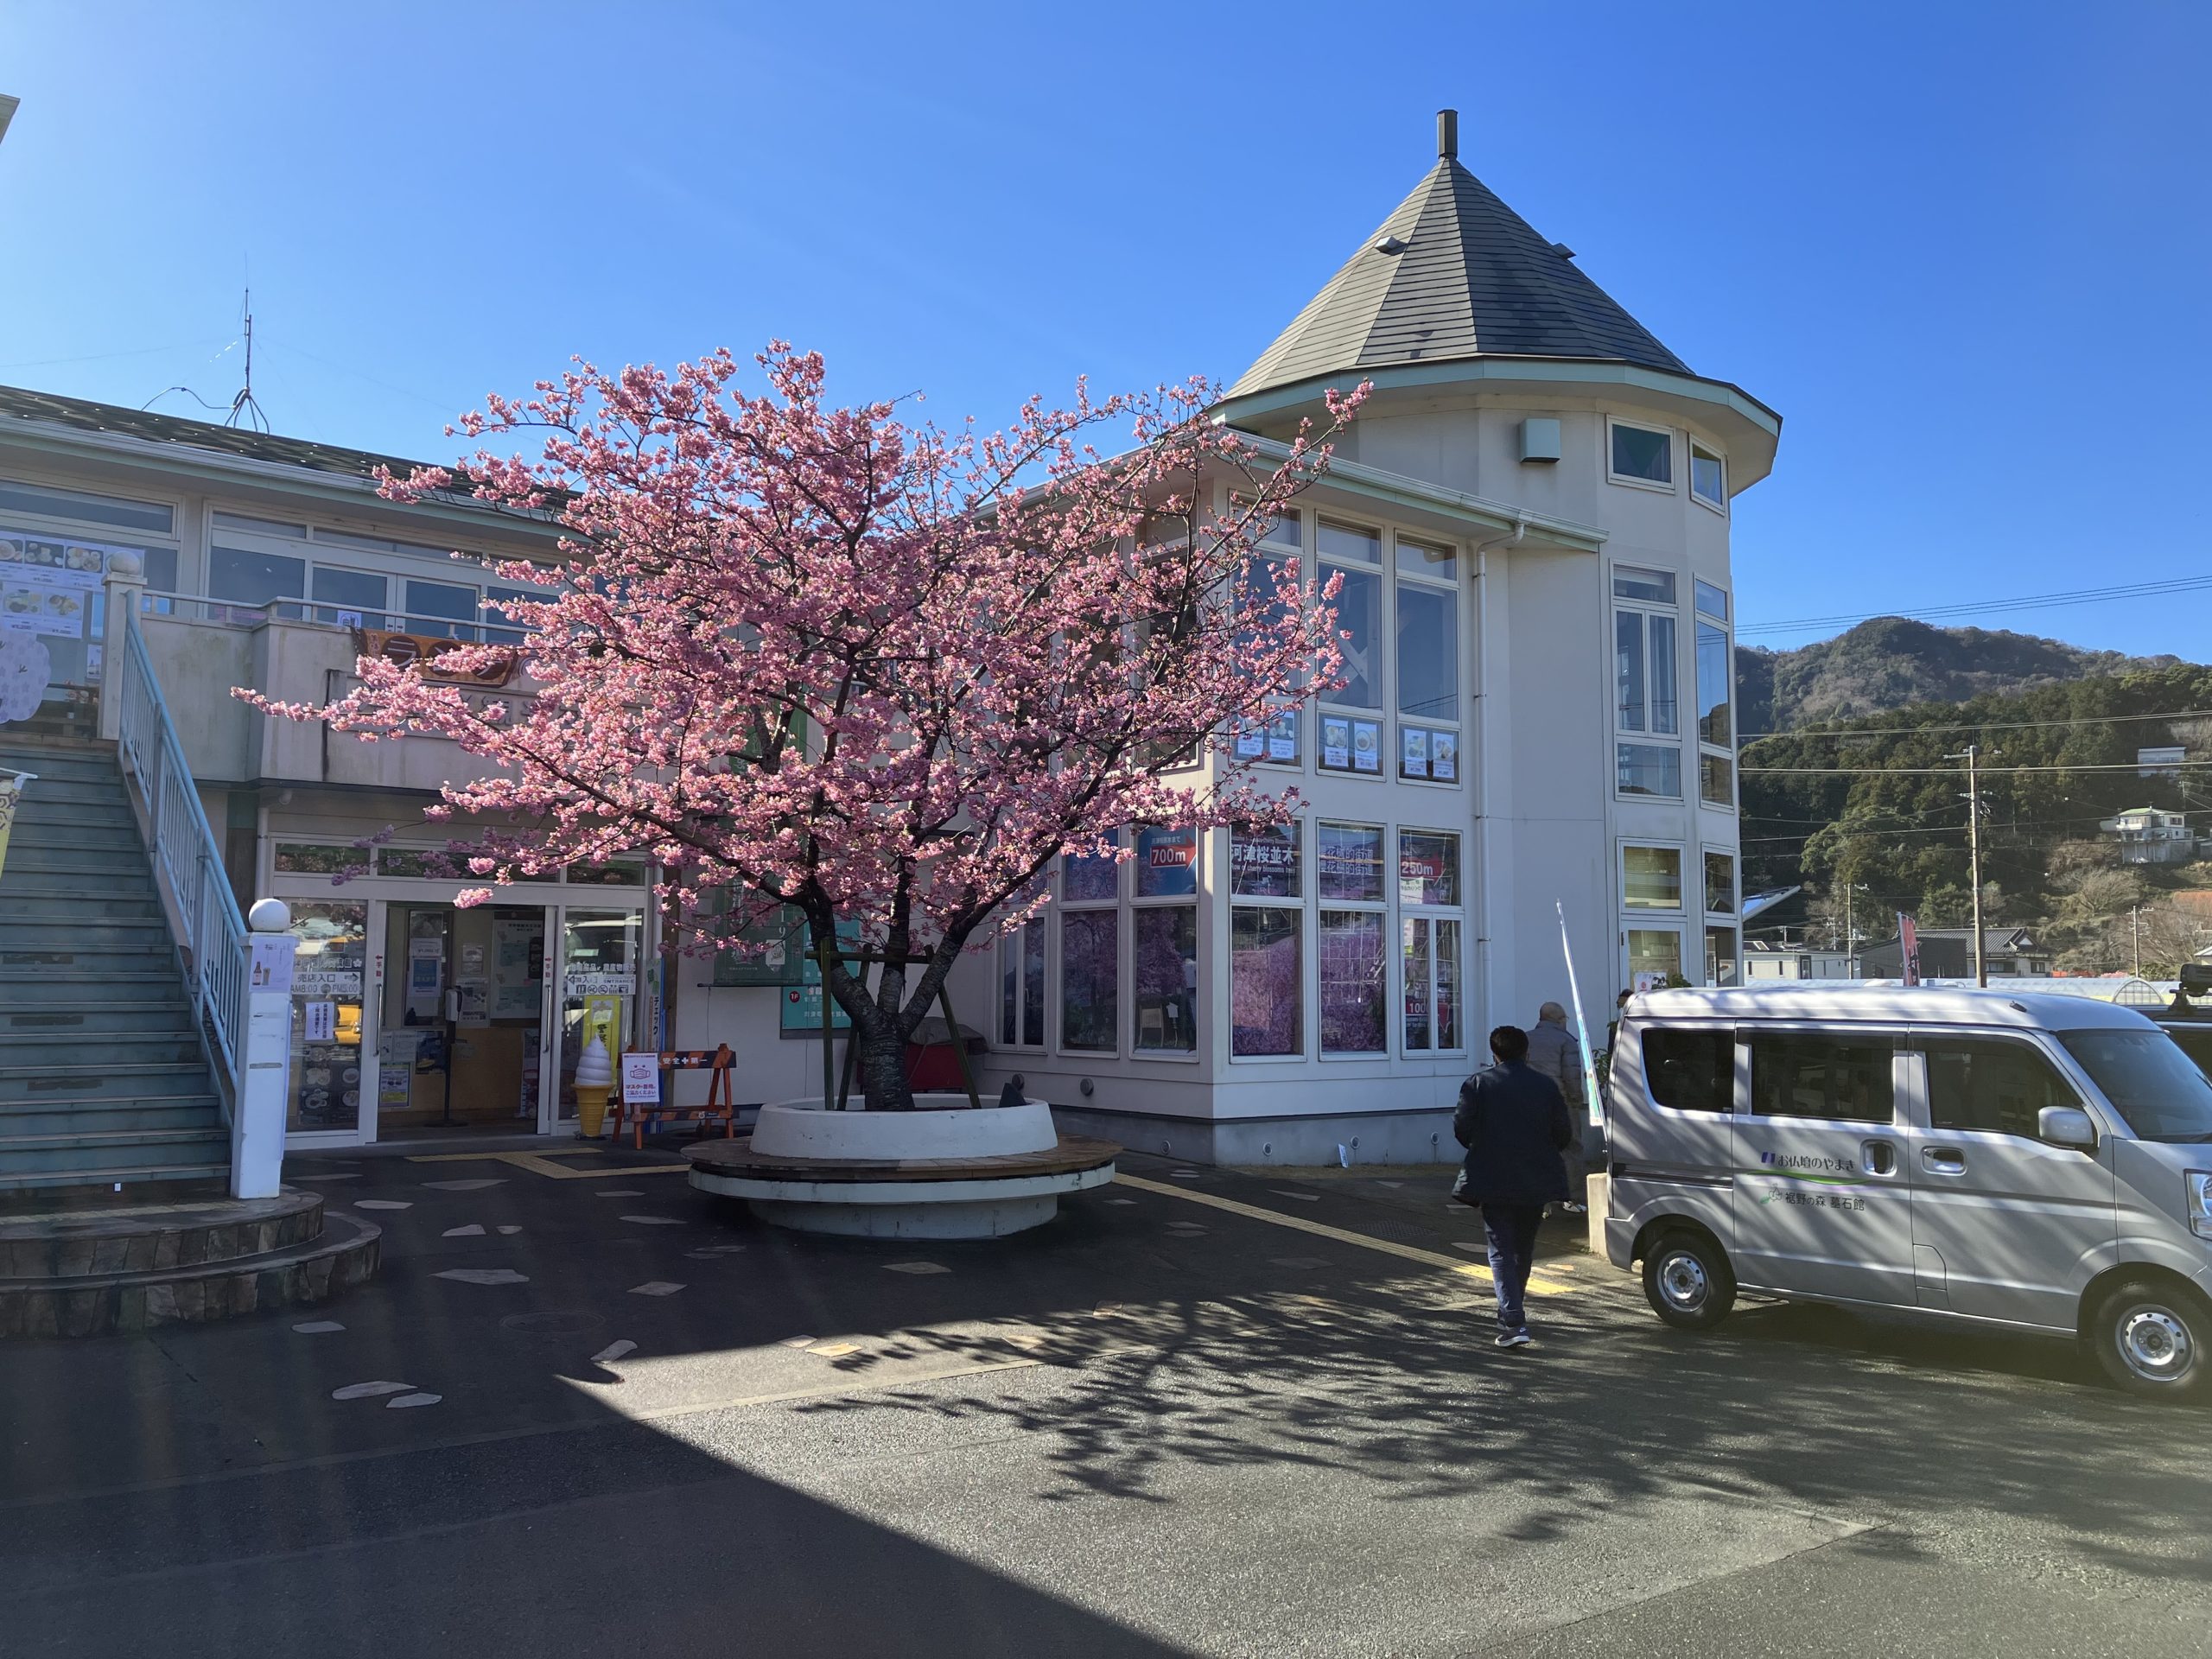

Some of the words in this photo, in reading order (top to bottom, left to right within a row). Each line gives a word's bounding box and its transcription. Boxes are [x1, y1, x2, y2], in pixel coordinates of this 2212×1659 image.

[1152, 848, 1186, 865] 700m
[1230, 843, 1294, 865] 河津桜並木
[1401, 861, 1433, 876] 250m
[297, 973, 336, 982] 売店入口
[1777, 1154, 1856, 1172] お仏壇のやまき
[1785, 1192, 1827, 1208] 裾野の森
[1829, 1196, 1866, 1211] 墓石館
